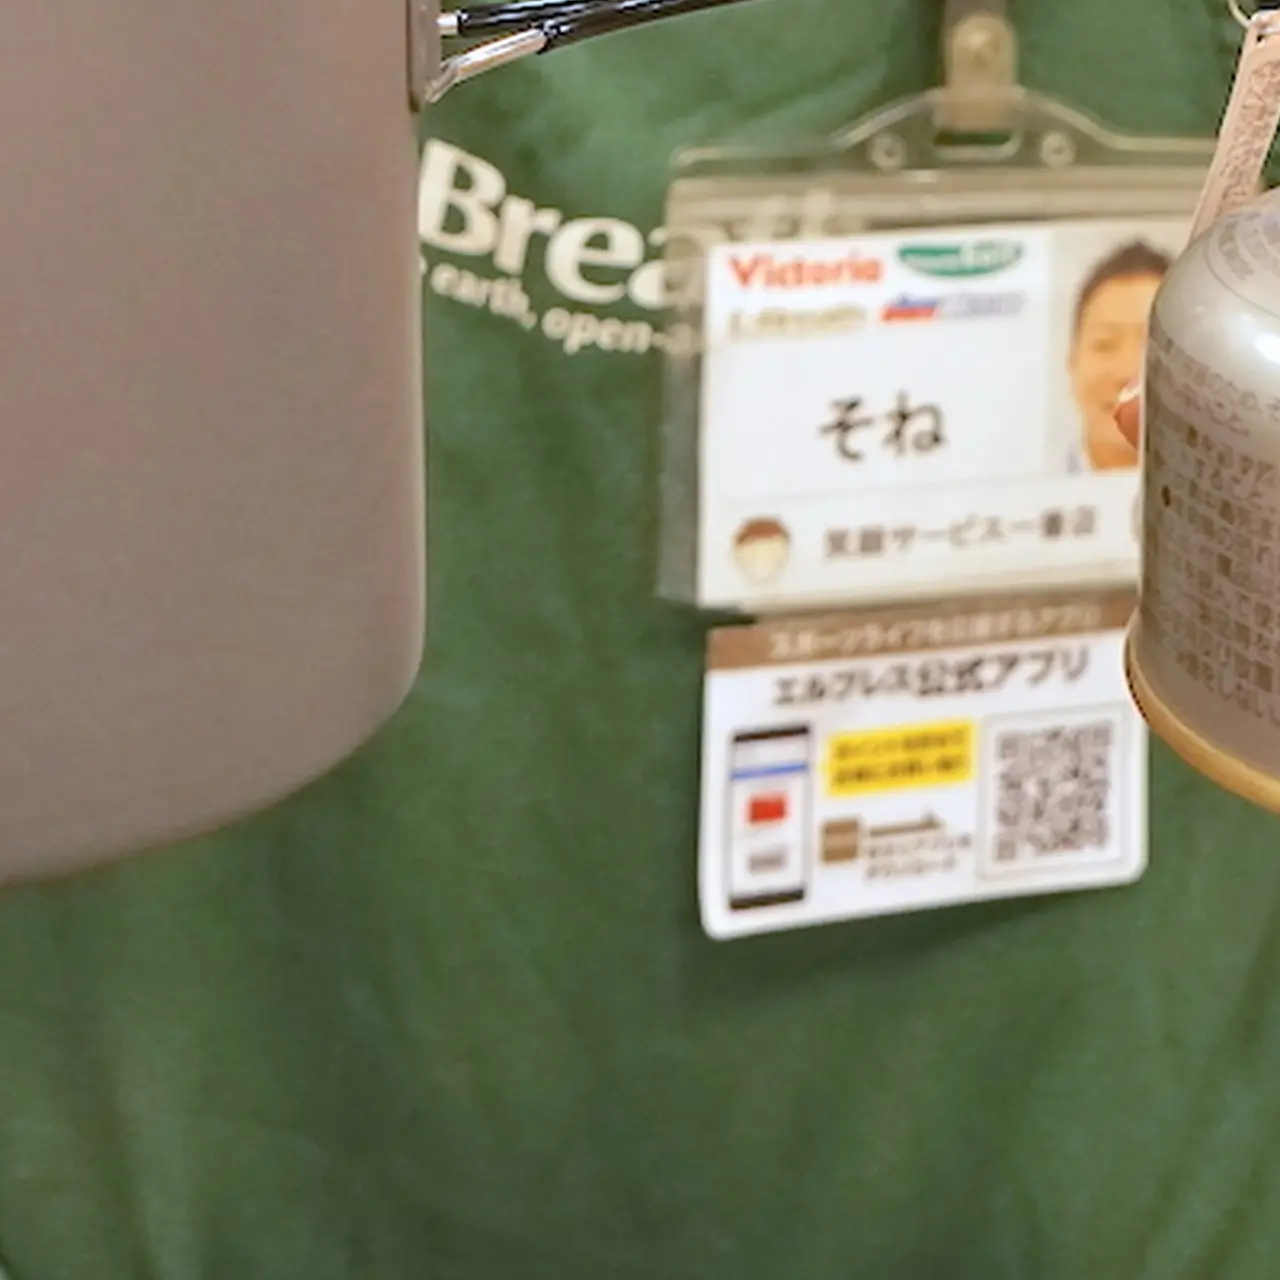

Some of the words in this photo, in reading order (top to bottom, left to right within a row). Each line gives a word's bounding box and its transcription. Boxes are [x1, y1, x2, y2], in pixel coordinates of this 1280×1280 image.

[417, 137, 790, 312] Brea
[728, 248, 883, 292] Victoria
[820, 391, 947, 462] そね
